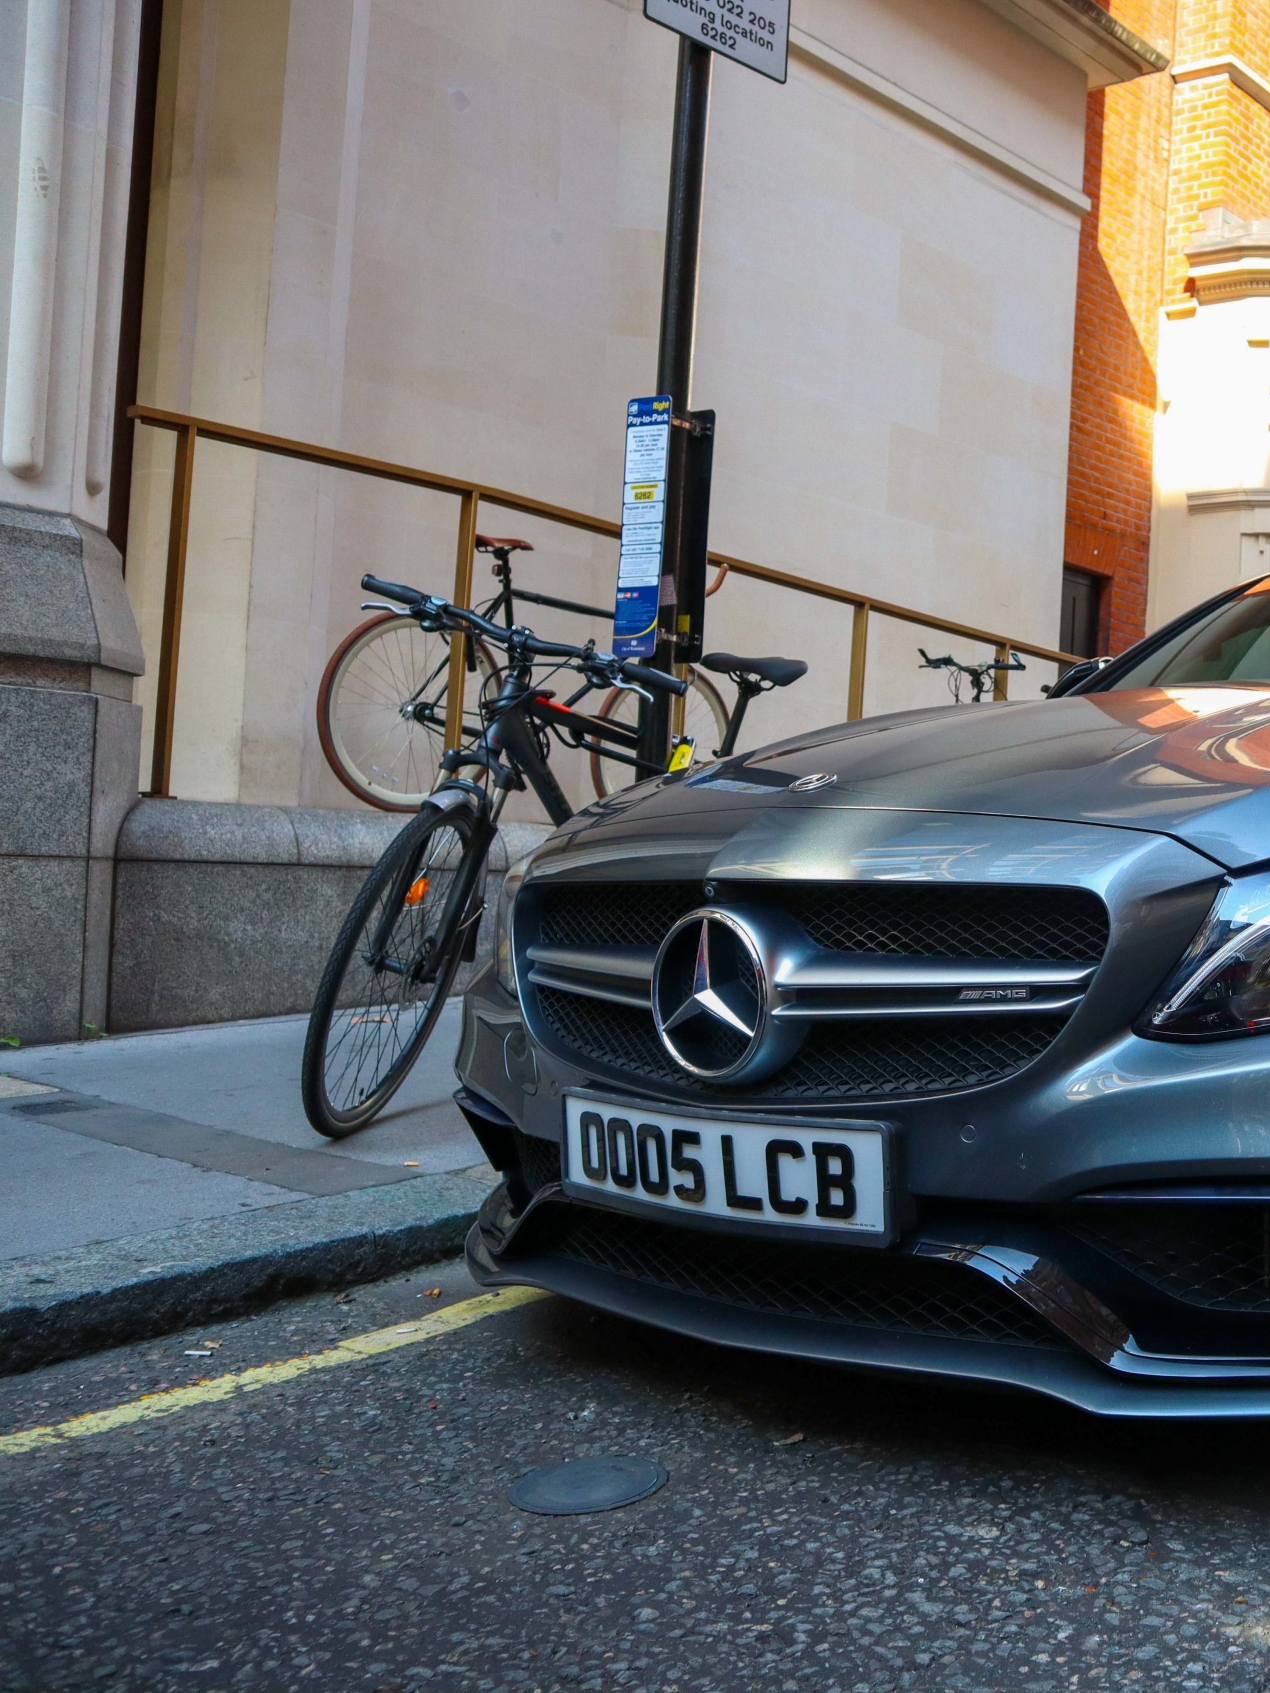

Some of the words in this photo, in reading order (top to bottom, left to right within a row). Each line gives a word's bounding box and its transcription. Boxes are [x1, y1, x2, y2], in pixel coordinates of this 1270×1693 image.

[667, 0, 716, 24] oting
[721, 13, 774, 52] location
[748, 11, 776, 35] 205
[701, 22, 737, 51] 6262
[627, 413, 669, 426] Pay-to-Park
[634, 491, 651, 500] 6262
[975, 989, 1027, 999] AMG
[721, 1134, 857, 1219] LCB
